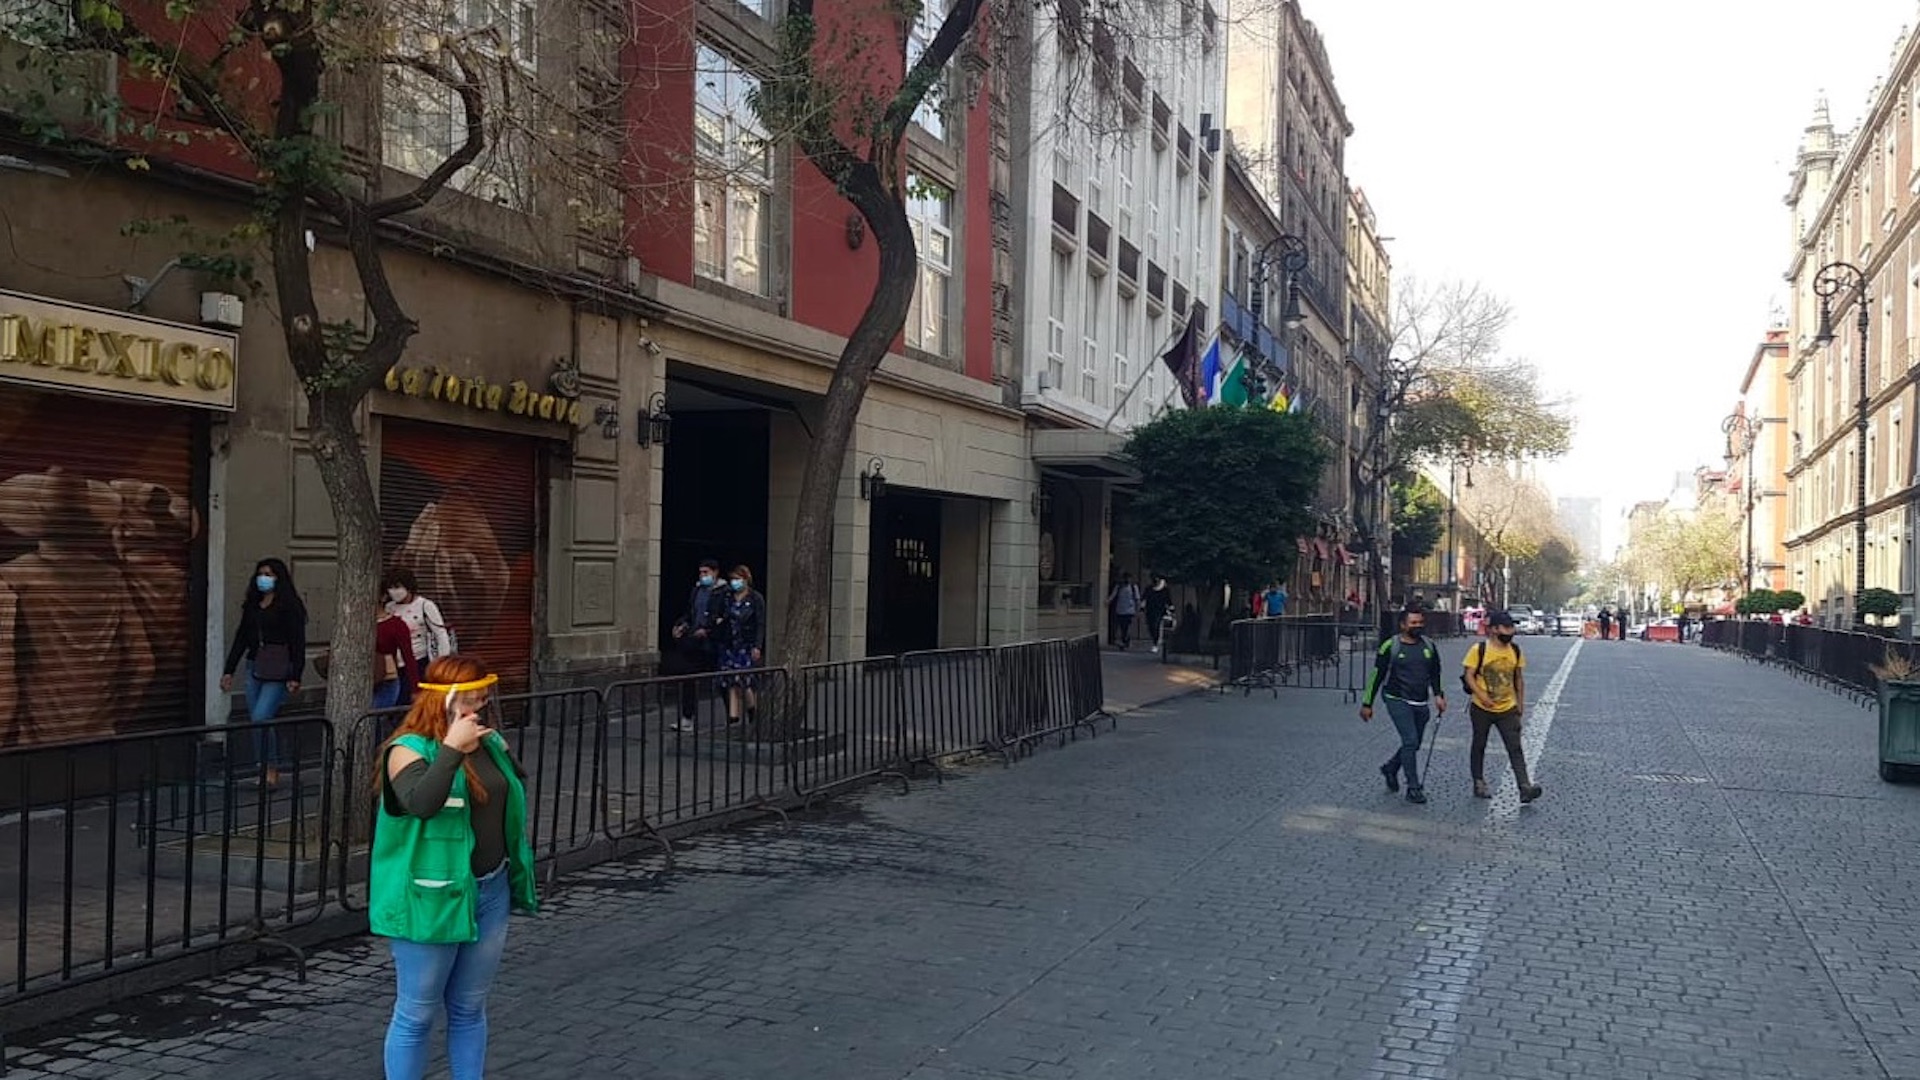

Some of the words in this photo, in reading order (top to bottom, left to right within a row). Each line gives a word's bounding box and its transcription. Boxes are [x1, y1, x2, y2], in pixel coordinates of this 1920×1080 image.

[384, 365, 423, 396] La
[429, 363, 503, 412] Torta
[508, 378, 584, 425] Brava
